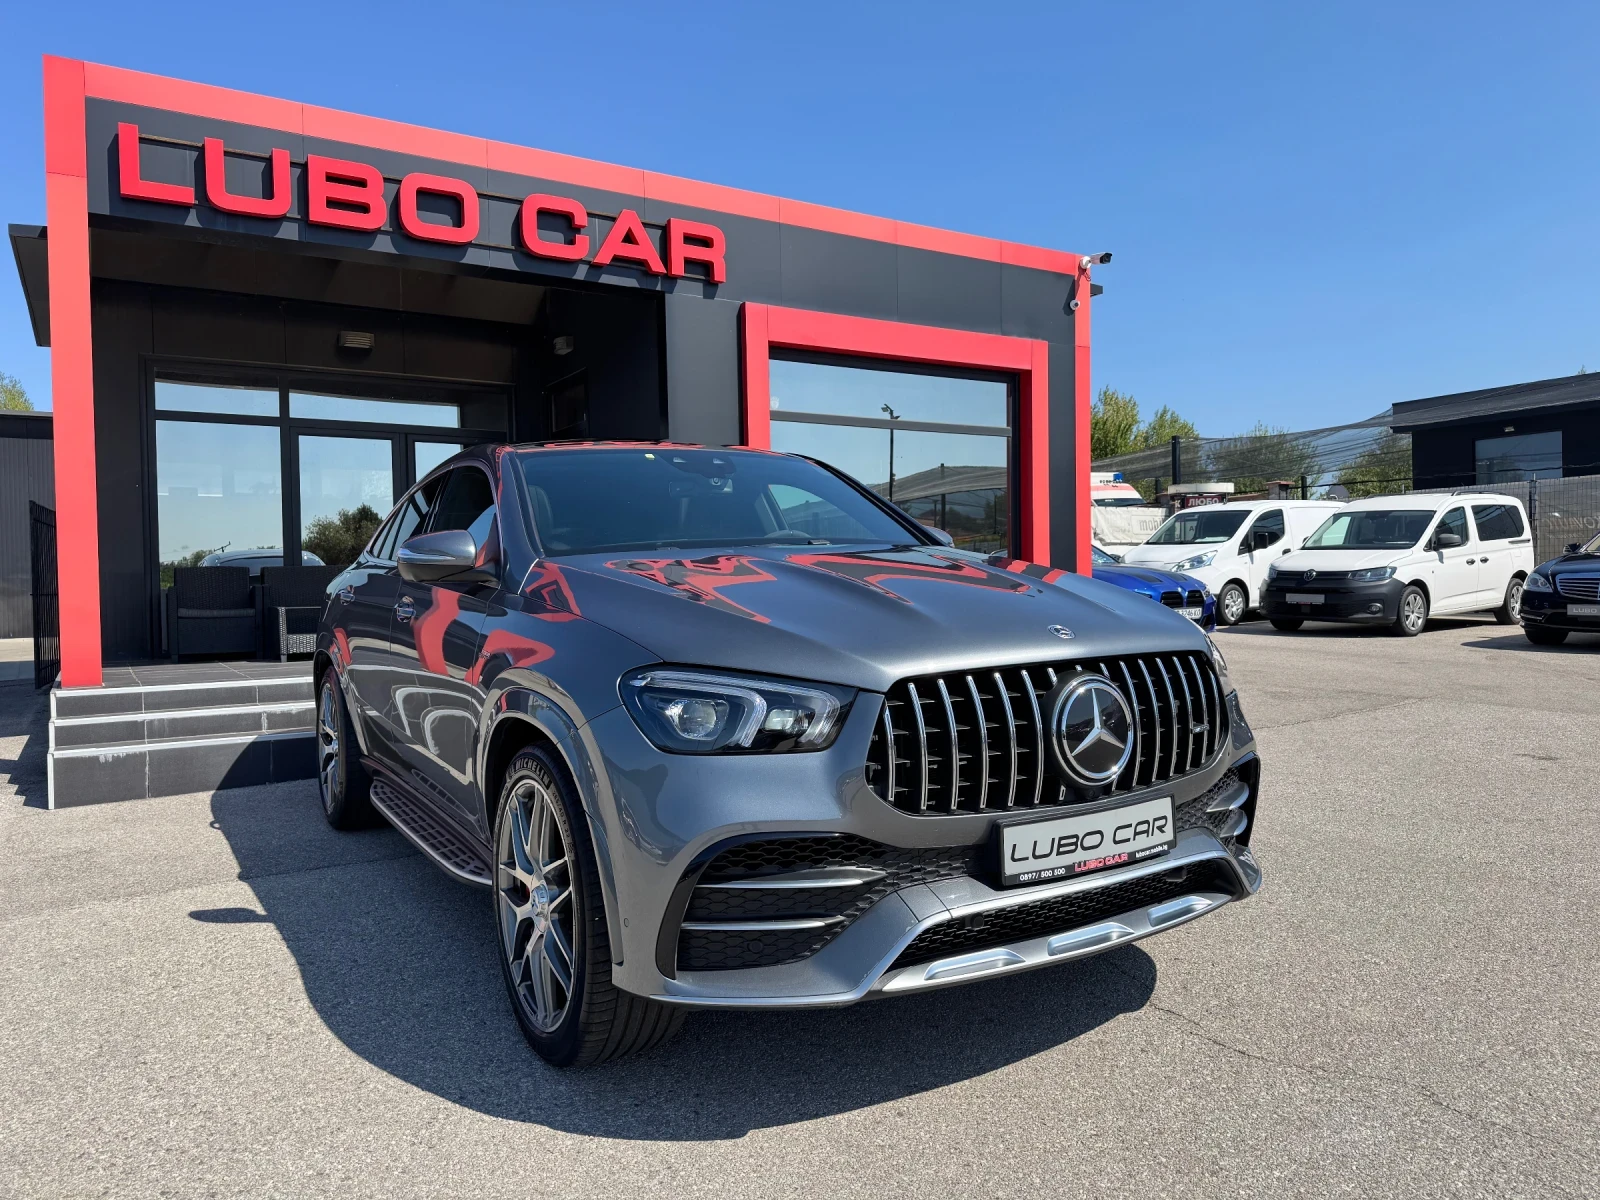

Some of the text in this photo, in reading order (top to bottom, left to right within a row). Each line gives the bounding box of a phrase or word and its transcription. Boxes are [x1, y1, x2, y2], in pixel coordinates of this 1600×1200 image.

[118, 121, 727, 285] LUBO CAR
[1188, 497, 1219, 507] ЛЮБО
[515, 757, 550, 785] MICHELIN
[1010, 815, 1168, 862] LUBO CAR
[1040, 870, 1052, 878] 500
[1053, 867, 1066, 875] 500
[1074, 852, 1128, 872] LUBO CAR
